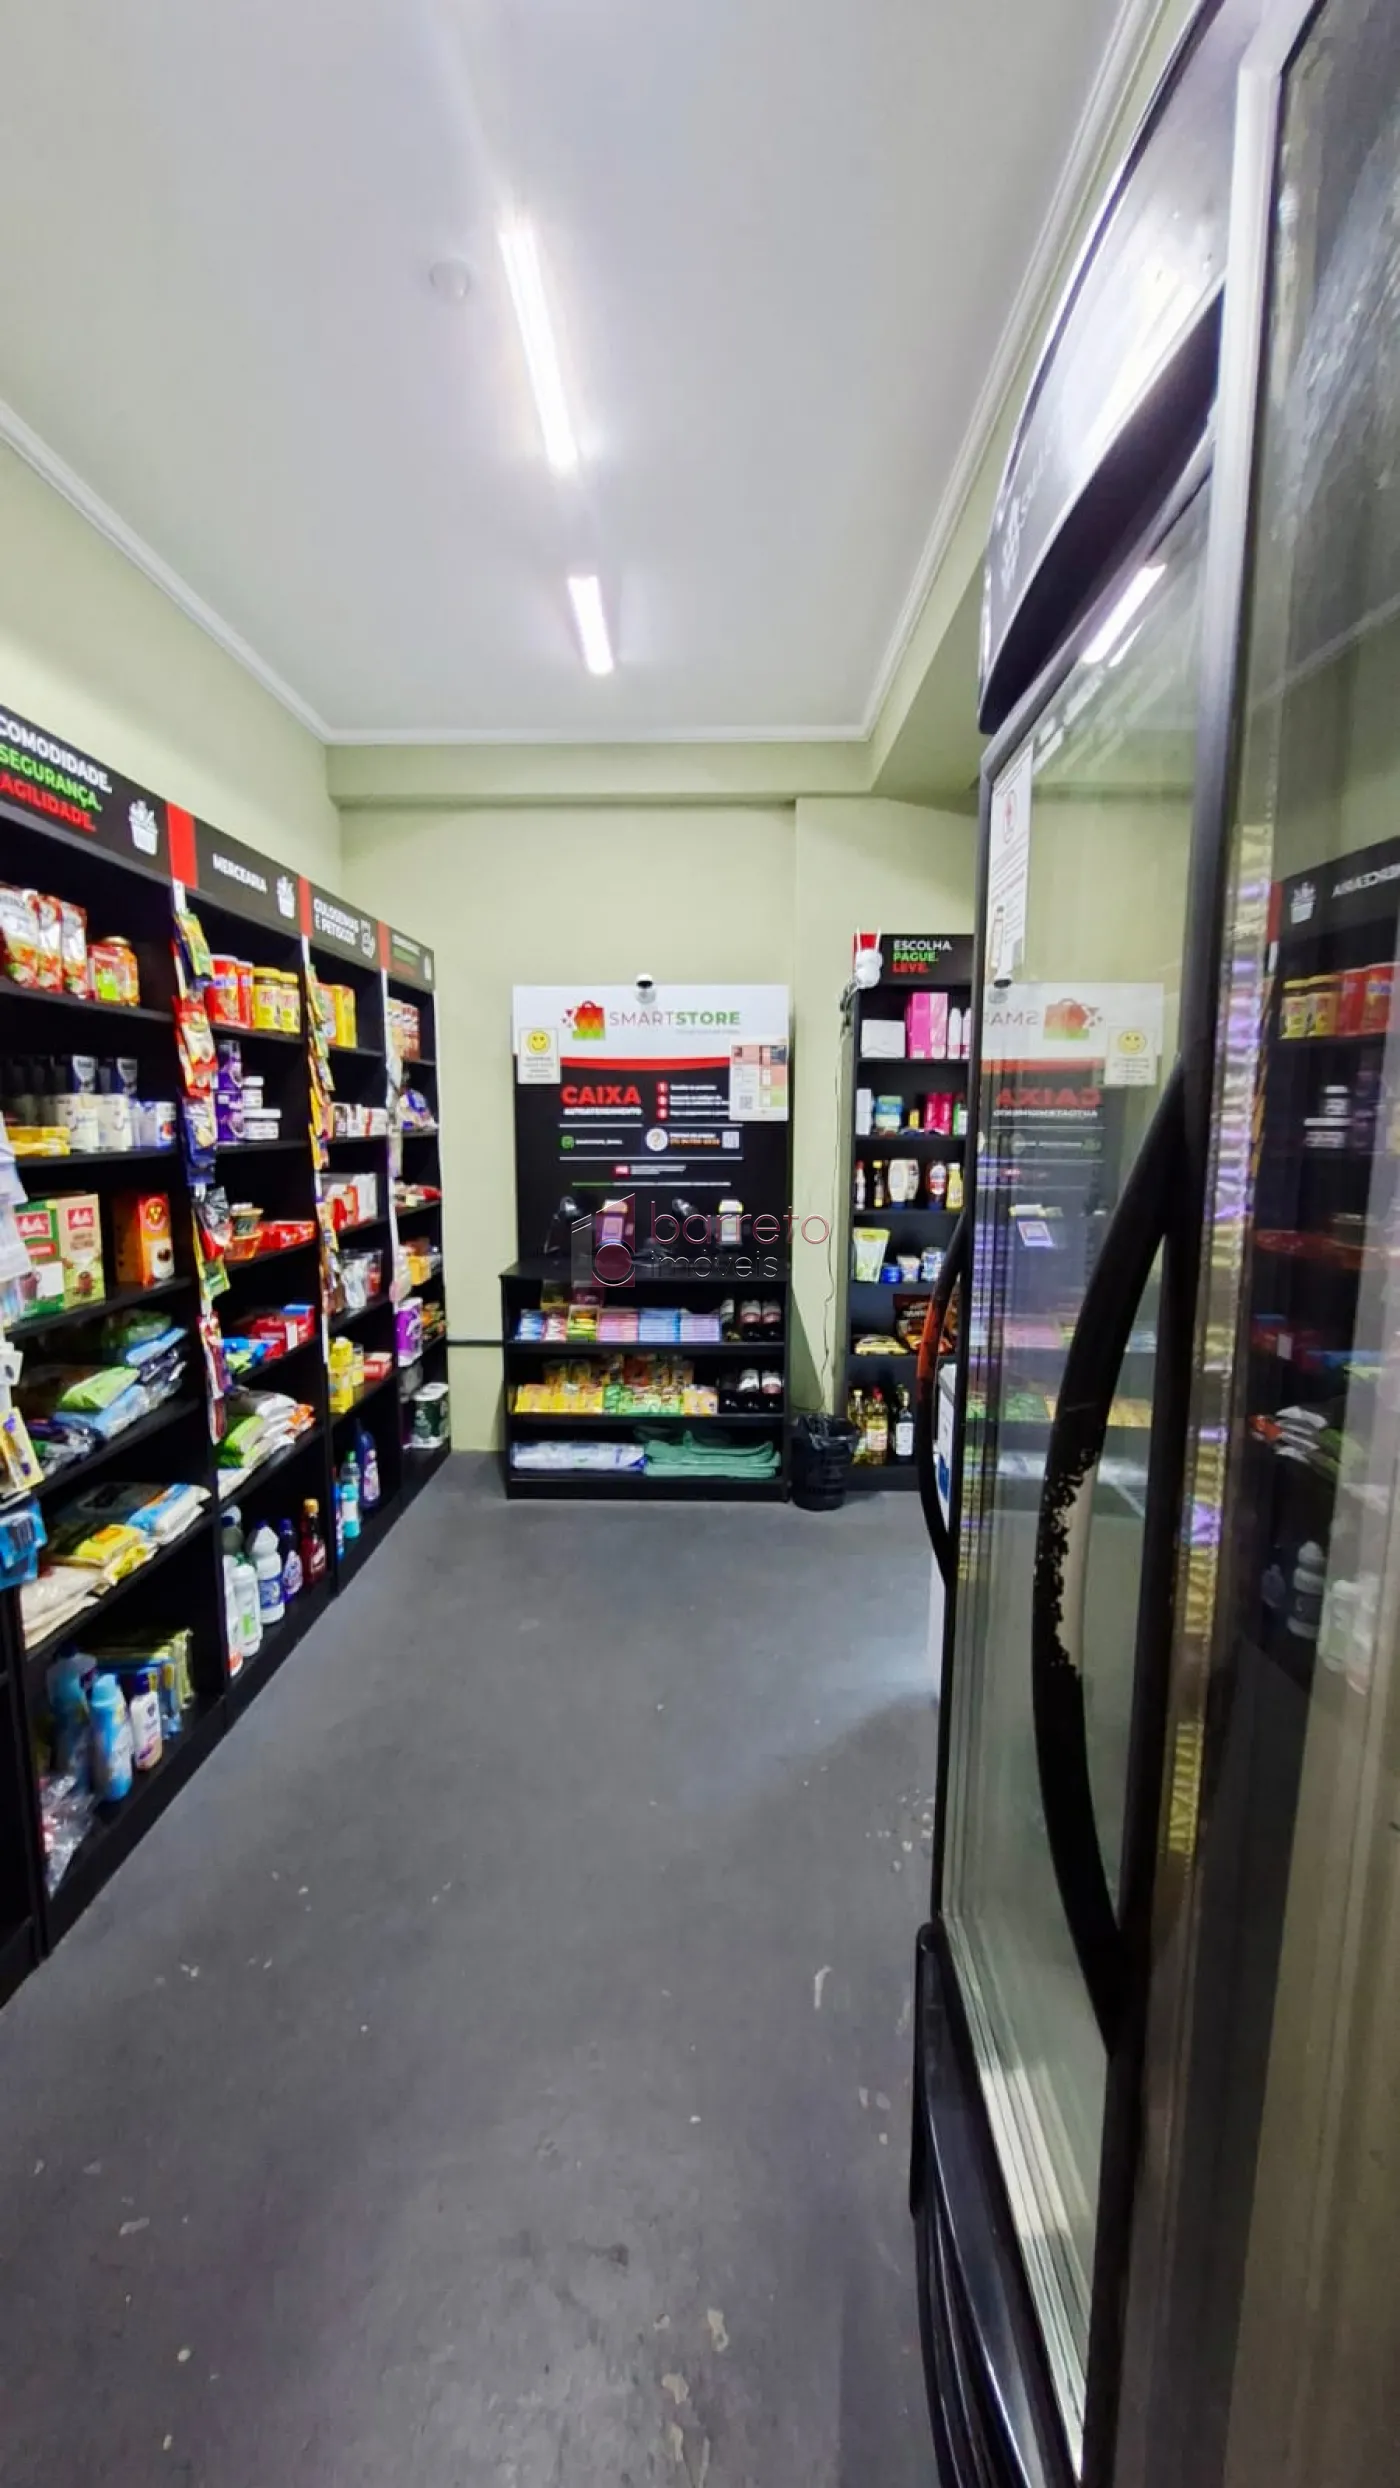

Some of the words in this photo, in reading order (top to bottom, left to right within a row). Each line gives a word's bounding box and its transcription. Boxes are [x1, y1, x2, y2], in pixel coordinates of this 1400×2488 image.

[0, 714, 113, 794] COMODIDADE.
[0, 743, 103, 812] SEGURANÇA.
[212, 852, 267, 893] MERCEARIA
[609, 1011, 741, 1027] SMARTSTORE
[560, 1085, 642, 1106] CAIXA
